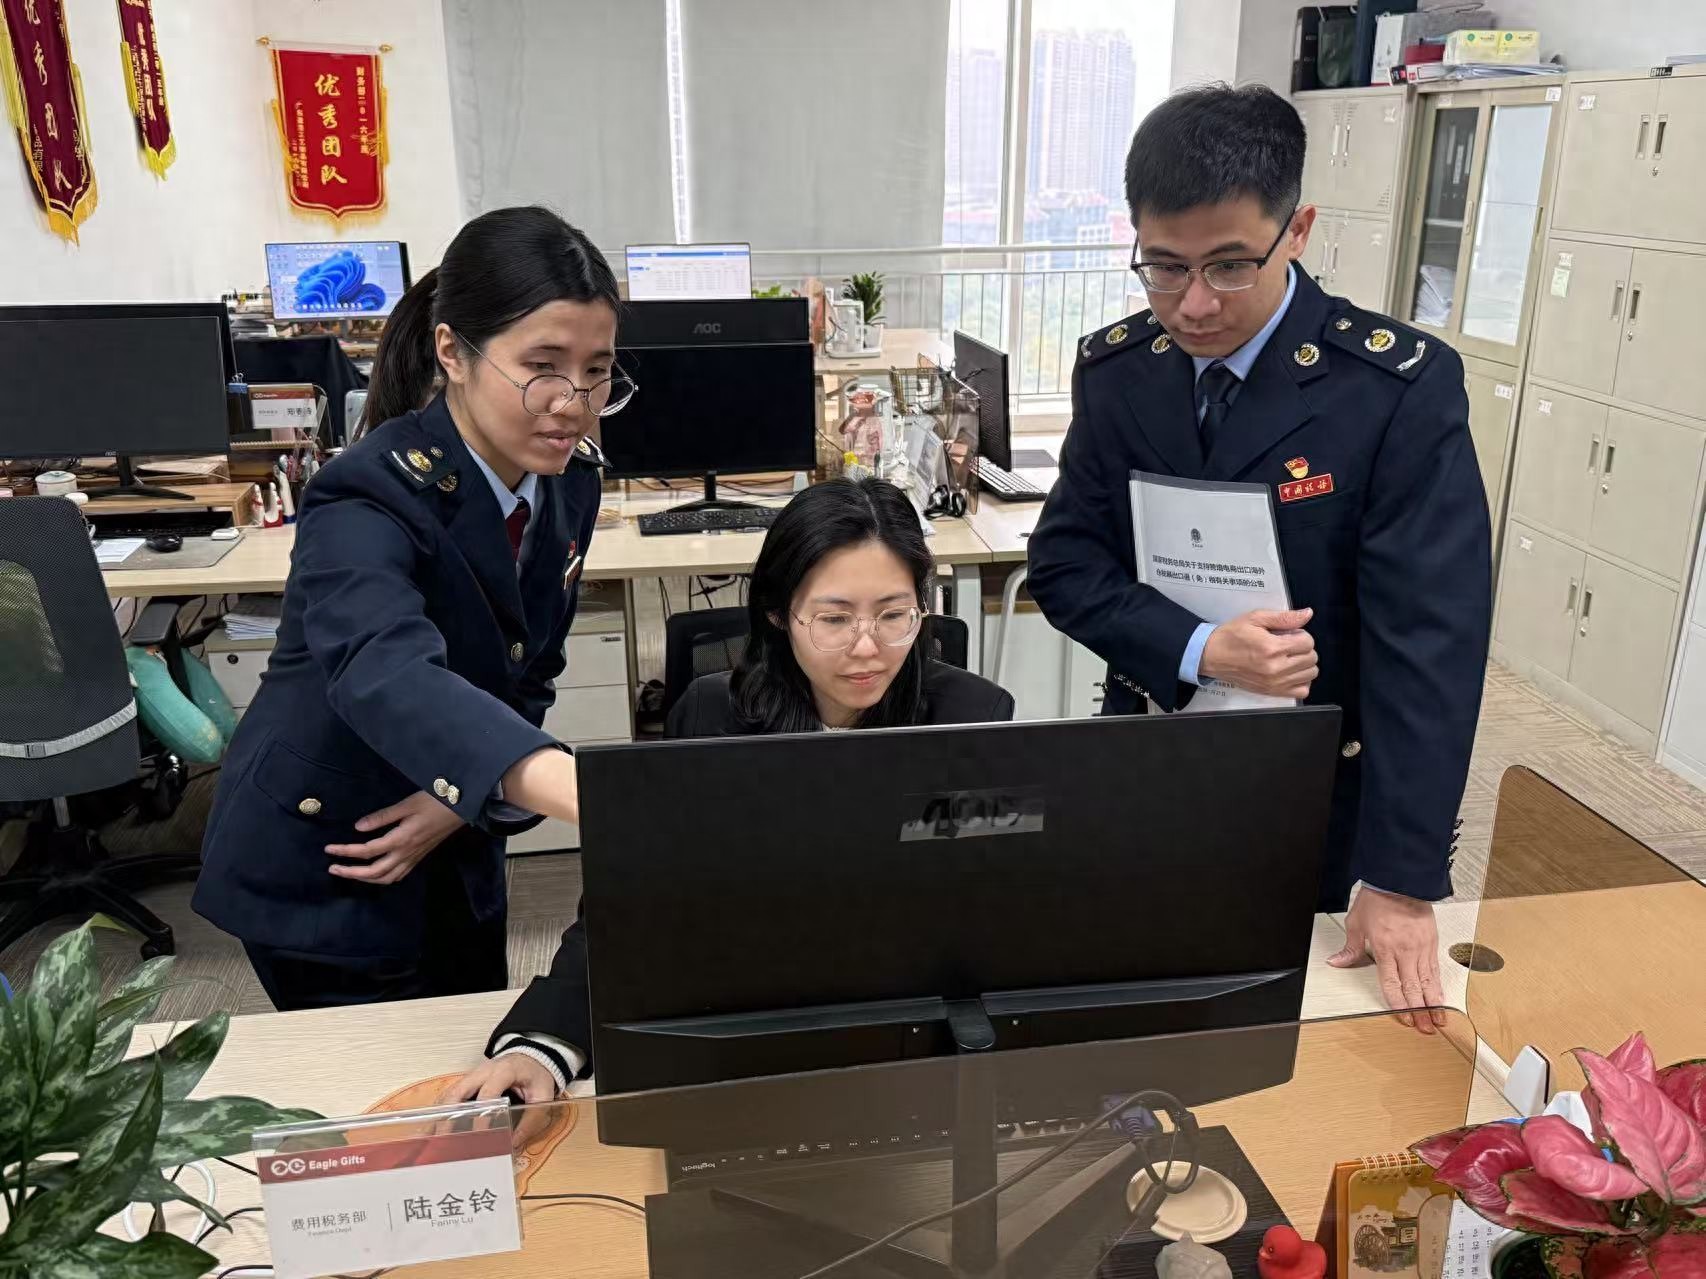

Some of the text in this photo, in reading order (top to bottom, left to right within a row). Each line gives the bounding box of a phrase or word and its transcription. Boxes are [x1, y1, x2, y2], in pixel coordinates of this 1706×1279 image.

[314, 73, 348, 185] 优秀团队
[309, 1156, 366, 1171] Eagle Gifts
[403, 1188, 498, 1222] 陆金铃
[291, 1210, 367, 1232] 费用税务部
